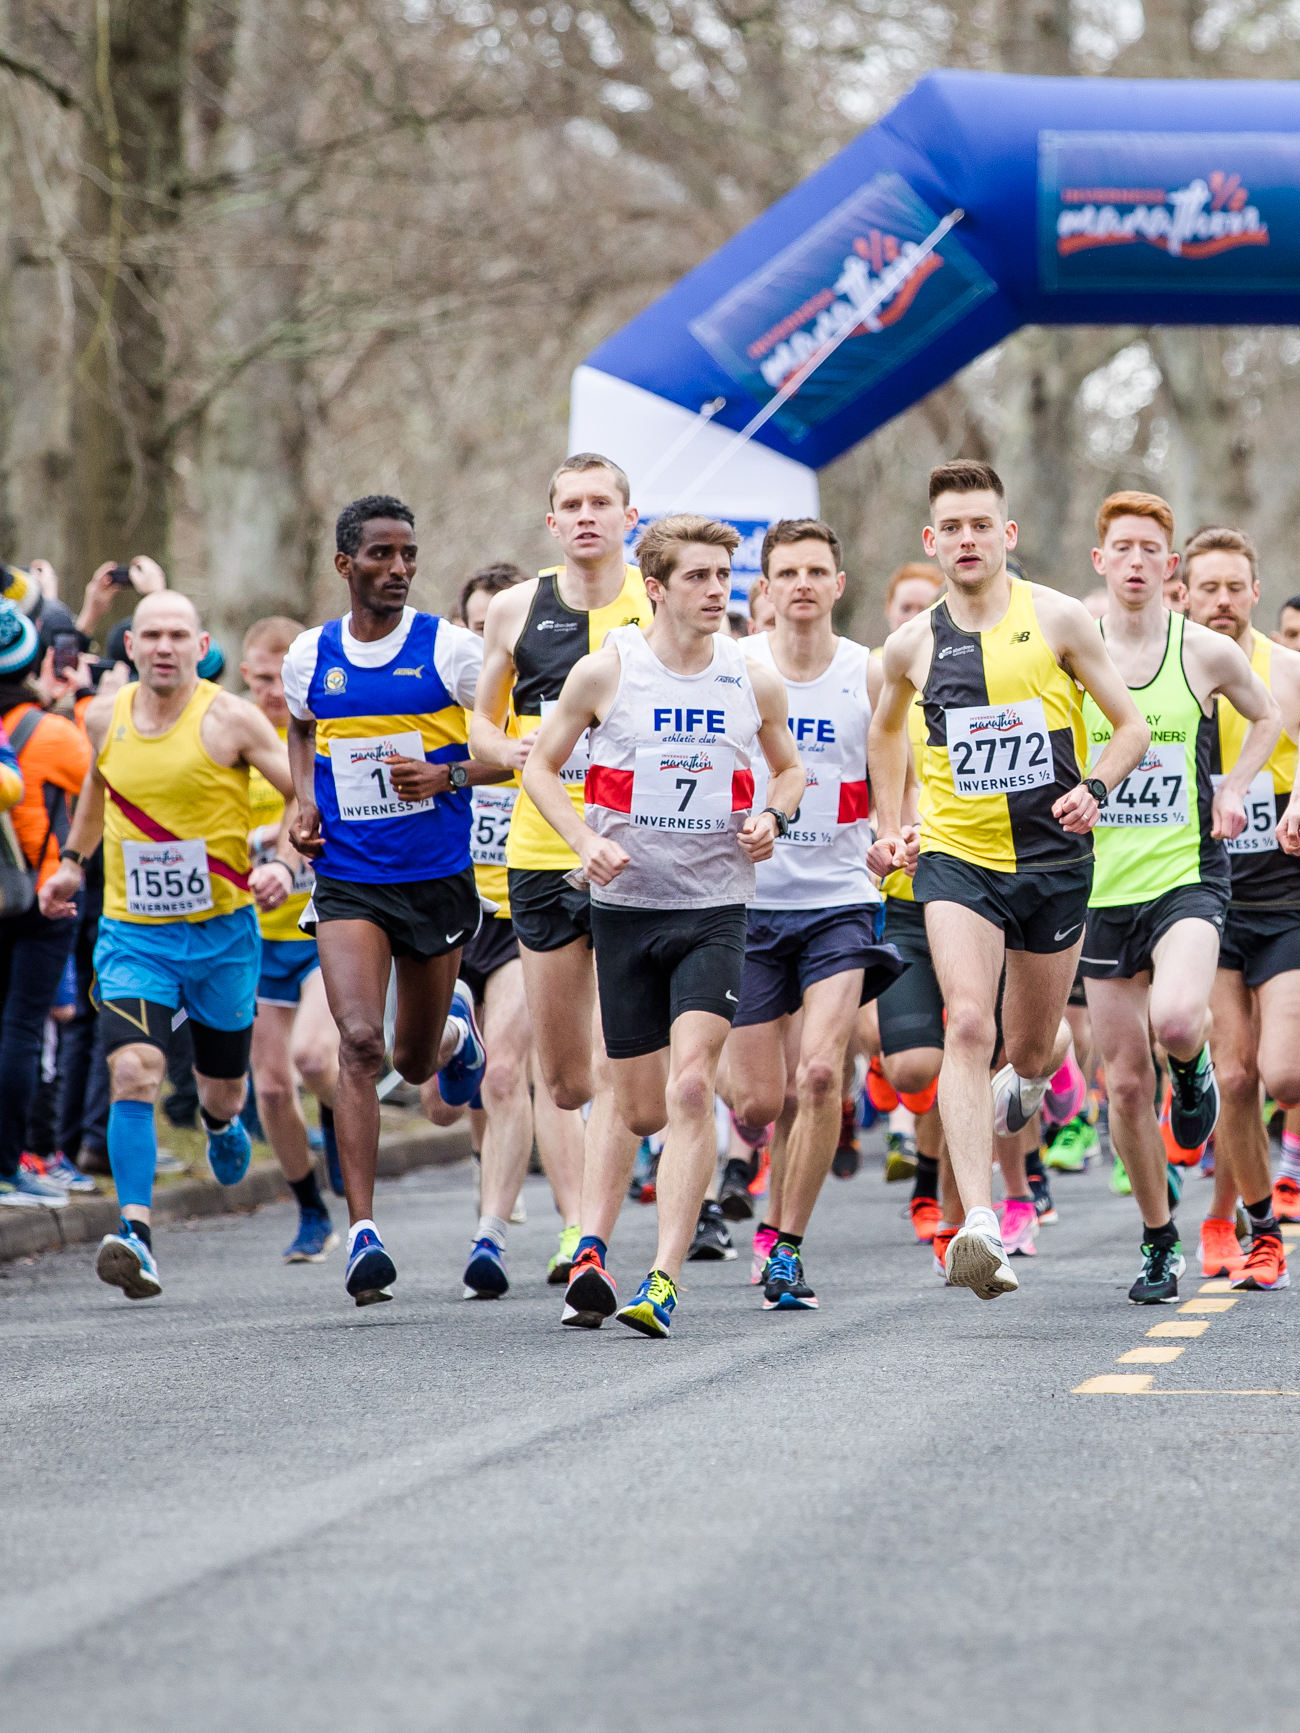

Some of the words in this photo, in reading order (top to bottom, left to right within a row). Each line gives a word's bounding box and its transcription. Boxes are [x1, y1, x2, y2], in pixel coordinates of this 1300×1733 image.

[1057, 178, 1267, 257] marathon
[654, 708, 726, 733] FIFE
[970, 712, 1020, 731] marathon
[662, 733, 695, 743] athletic
[699, 734, 716, 743] club
[788, 718, 835, 743] IFE
[350, 744, 398, 762] marathon
[953, 732, 1048, 775] 2772
[660, 754, 711, 772] marathon
[371, 768, 387, 799] 1
[959, 774, 1035, 791] INVERNESS
[1101, 775, 1182, 807] 447
[676, 779, 697, 812] 7
[342, 802, 413, 817] INVERNESS
[1100, 813, 1168, 823] NVERNESS
[635, 815, 711, 830] INVERNESS
[130, 867, 205, 897] 1556
[130, 901, 193, 911] INVERNESS
